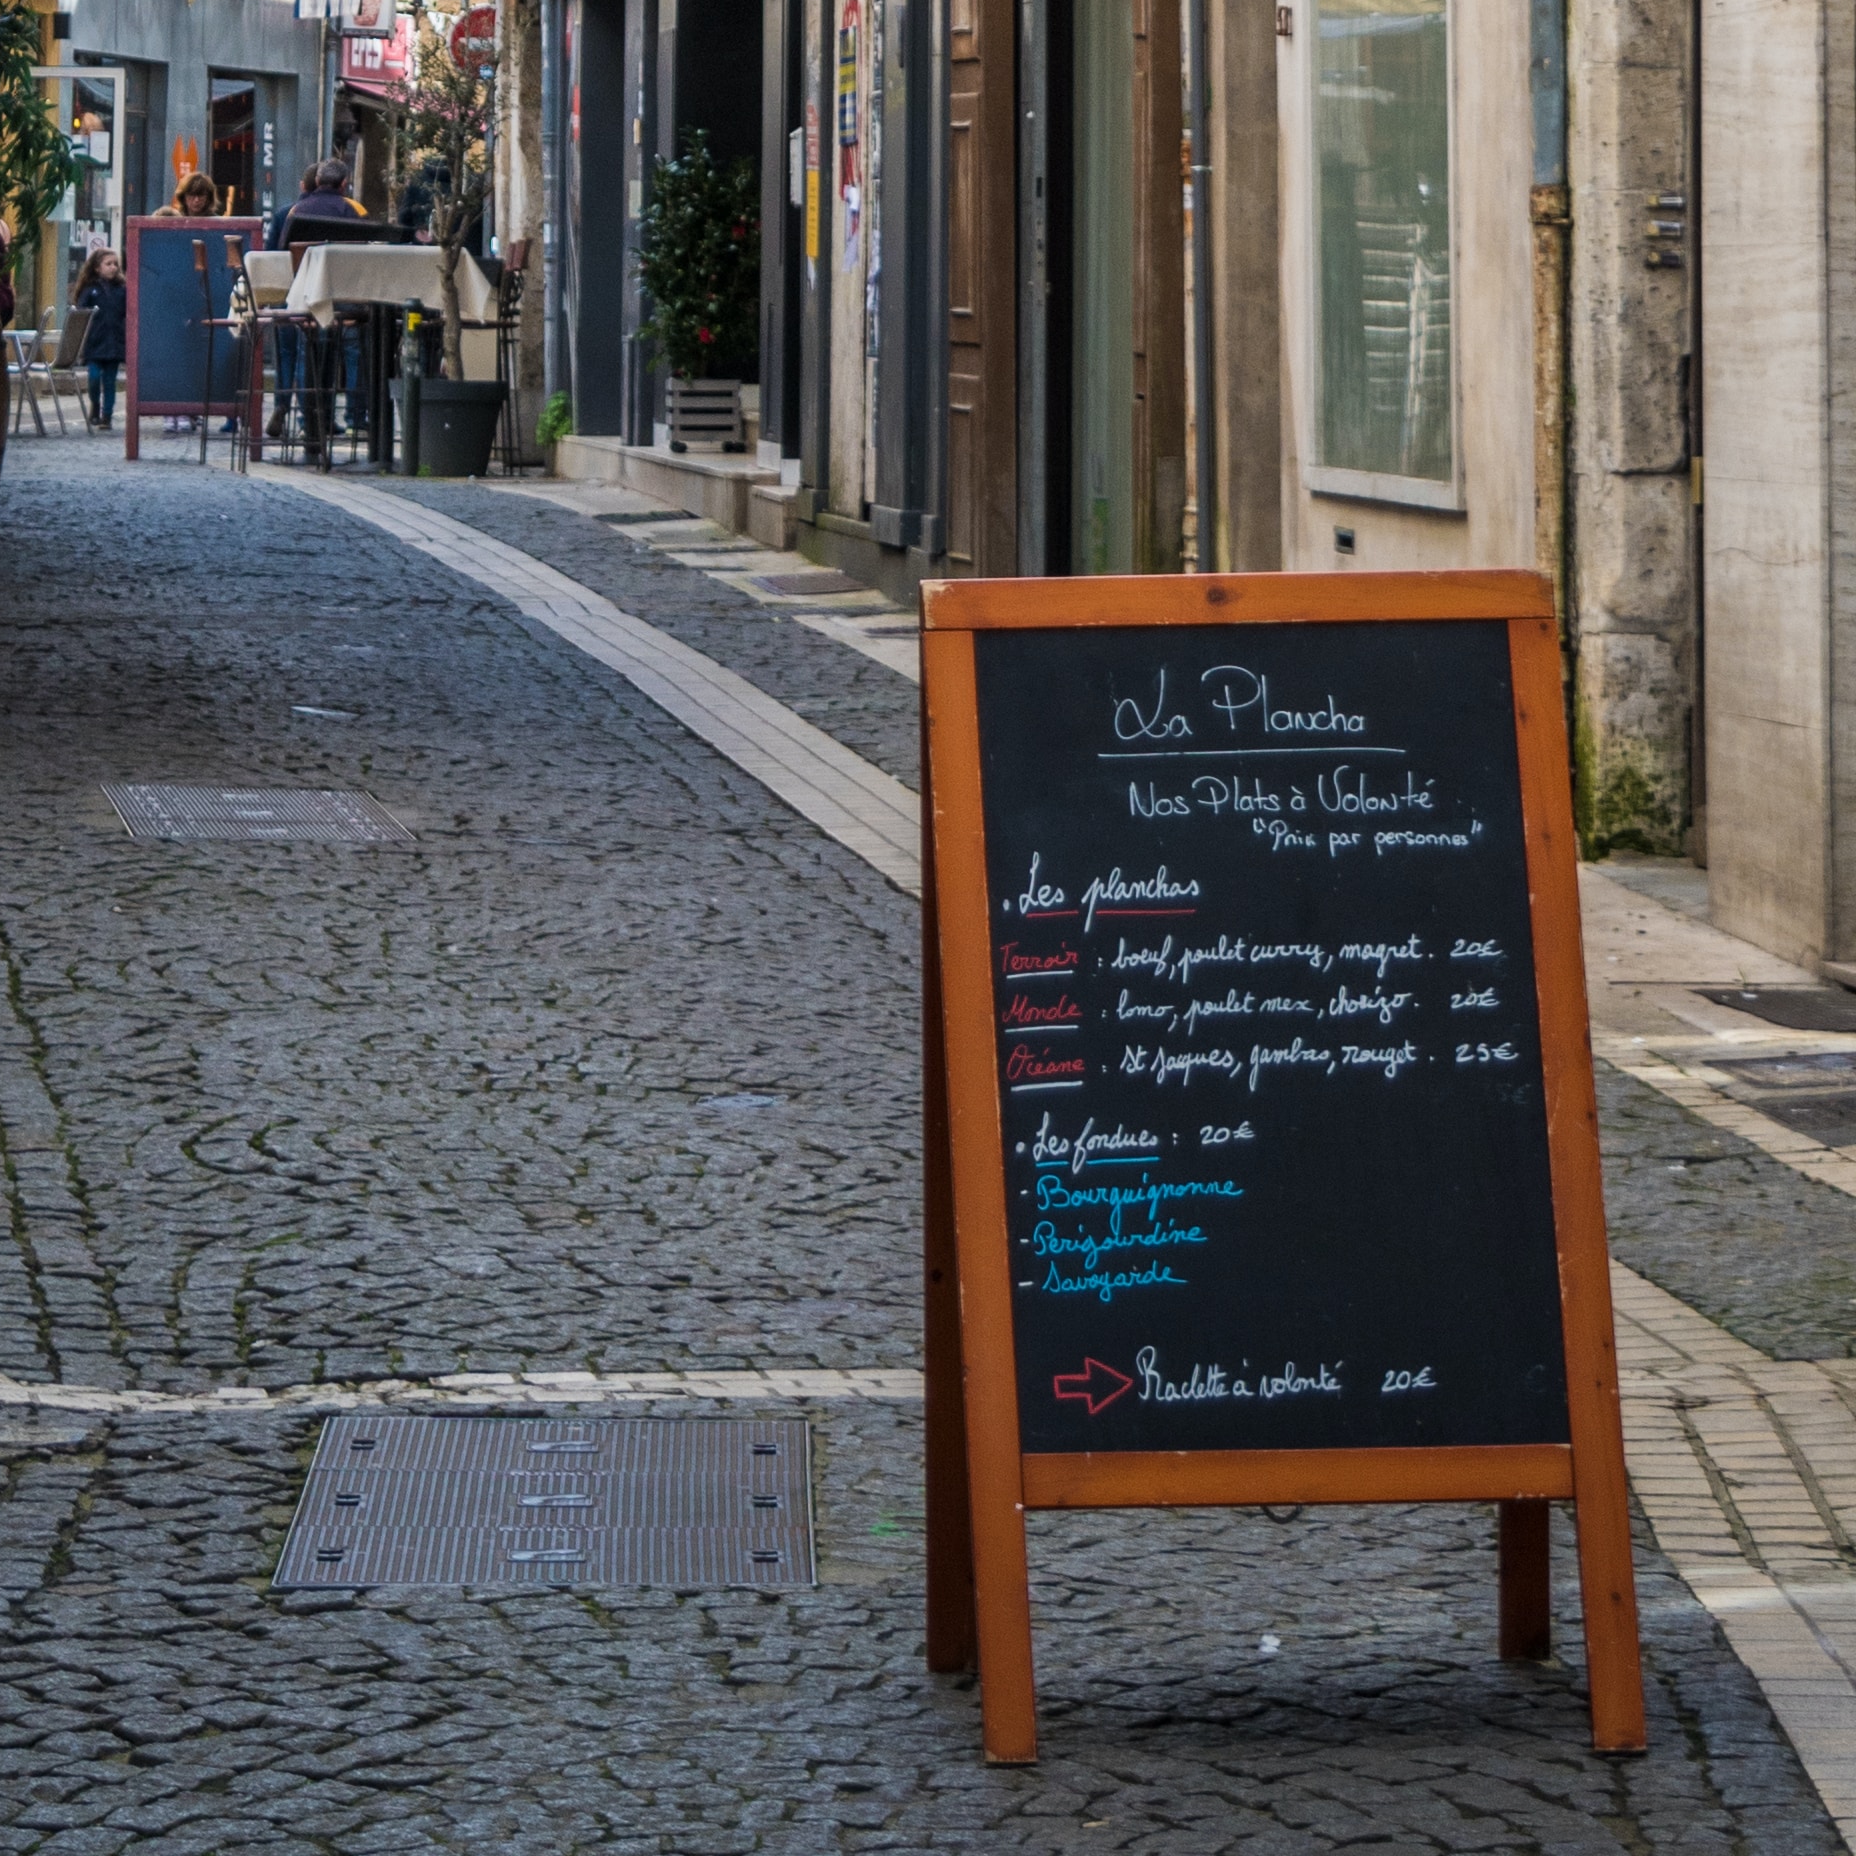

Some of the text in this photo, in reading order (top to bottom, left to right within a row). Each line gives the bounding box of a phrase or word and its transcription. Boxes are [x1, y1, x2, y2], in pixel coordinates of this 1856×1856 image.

[1115, 665, 1366, 739] La Plancha
[1129, 765, 1436, 817] Nos Plats à Volonté
[1329, 831, 1361, 857] par
[1020, 851, 1200, 933] Les planchas
[1001, 941, 1079, 972] Terroir
[1177, 934, 1246, 984] poulet
[1450, 938, 1503, 957] 20€
[1002, 994, 1083, 1023] Monde
[1182, 988, 1253, 1037] poulet
[1450, 987, 1500, 1009] 20€
[1006, 1043, 1086, 1081] Océane
[1120, 1044, 1147, 1073] St
[1455, 1042, 1519, 1062] 25€
[1033, 1111, 1256, 1175] Les fondues 20€
[1036, 1172, 1244, 1236] Bourguignonne
[1042, 1260, 1189, 1303] Savoyarde
[1136, 1345, 1438, 1401] Raclette à volonté 20€
